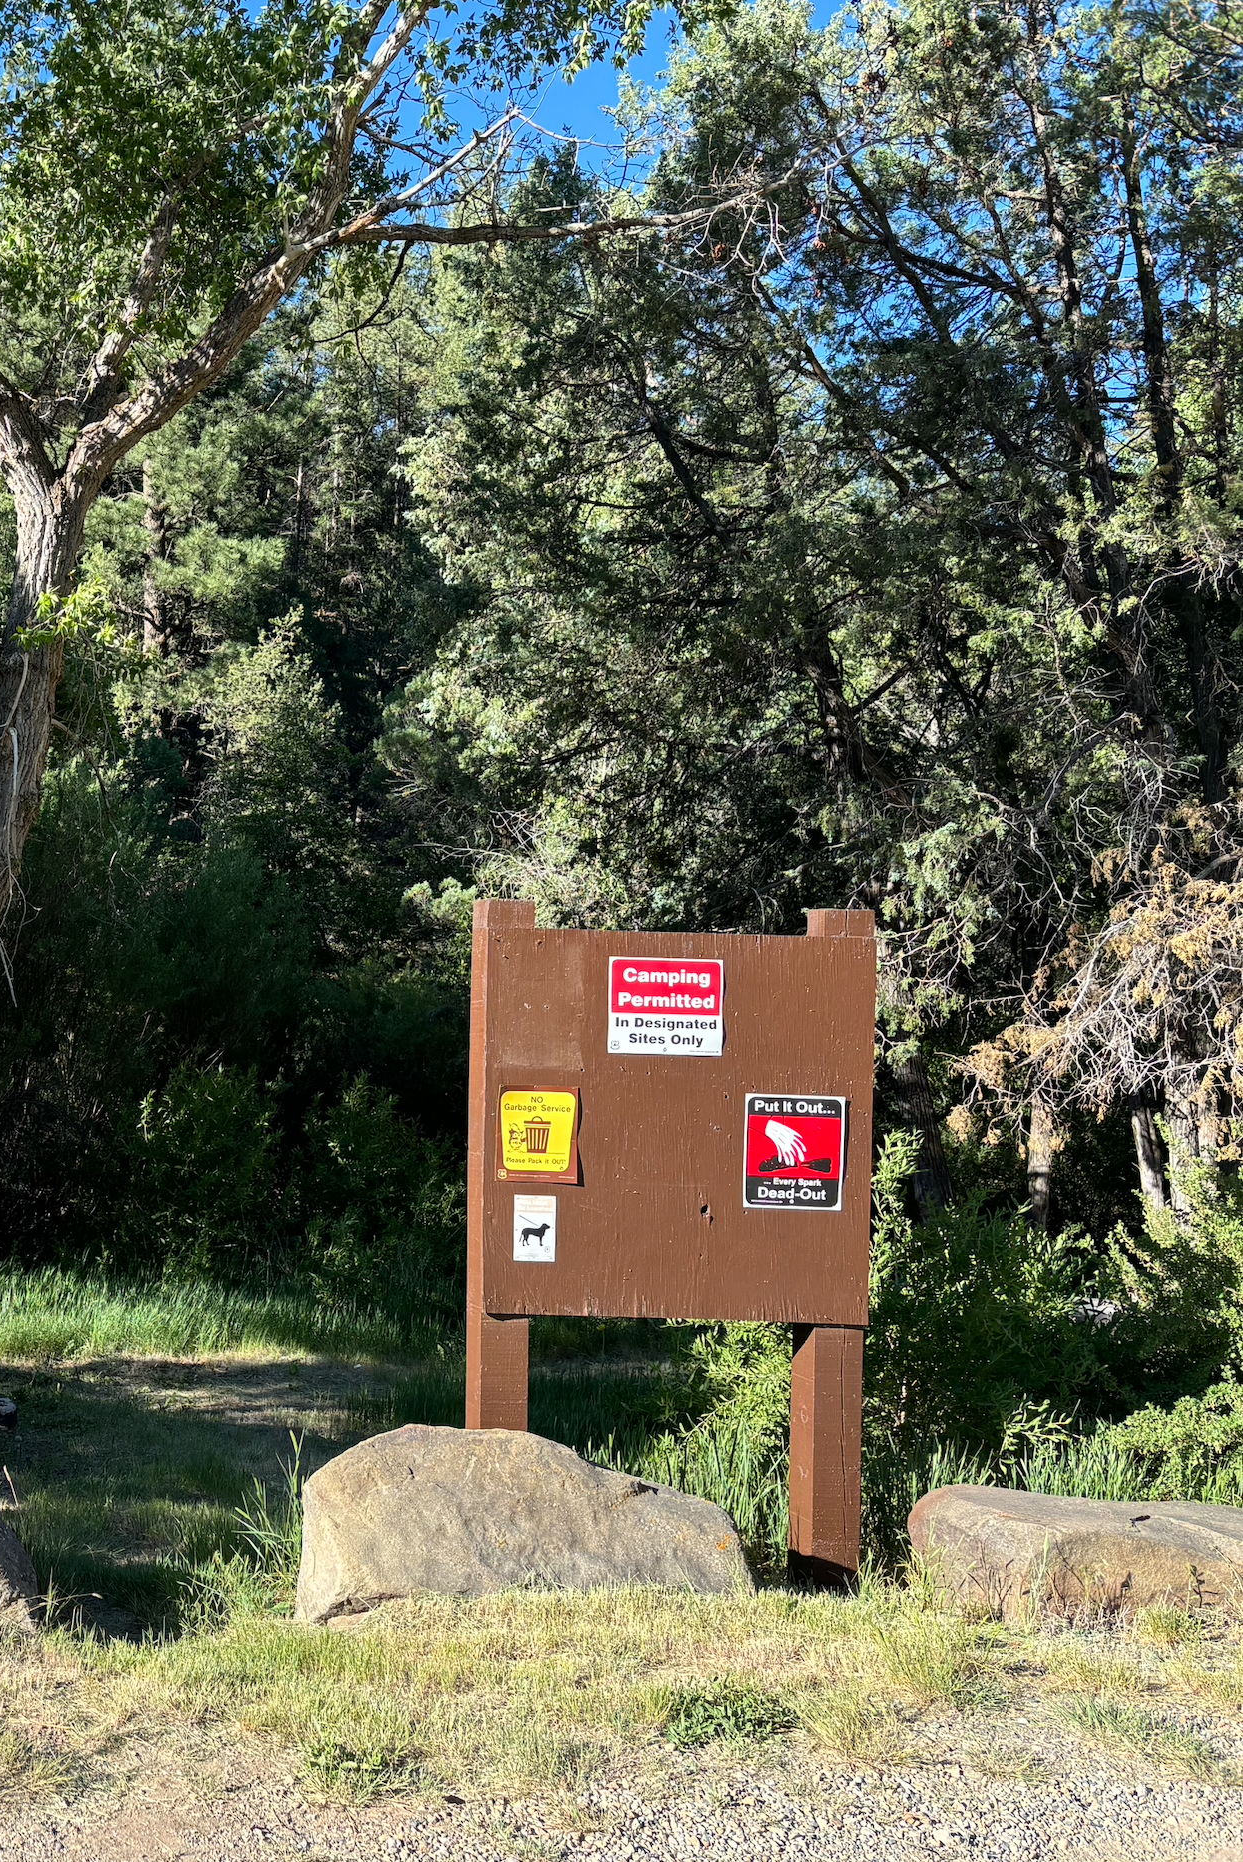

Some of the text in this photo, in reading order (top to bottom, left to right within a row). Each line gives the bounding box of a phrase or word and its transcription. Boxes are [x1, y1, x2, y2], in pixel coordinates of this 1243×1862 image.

[623, 967, 711, 988] Camping
[618, 992, 715, 1009] Permitted
[615, 1017, 717, 1031] In Designated
[629, 1033, 703, 1048] Sites Only
[504, 1103, 571, 1113] Garbage Service
[754, 1100, 835, 1114] Put It Out...
[773, 1177, 797, 1187] Every
[798, 1178, 822, 1187] Spark
[757, 1186, 827, 1200] Dead-Out
